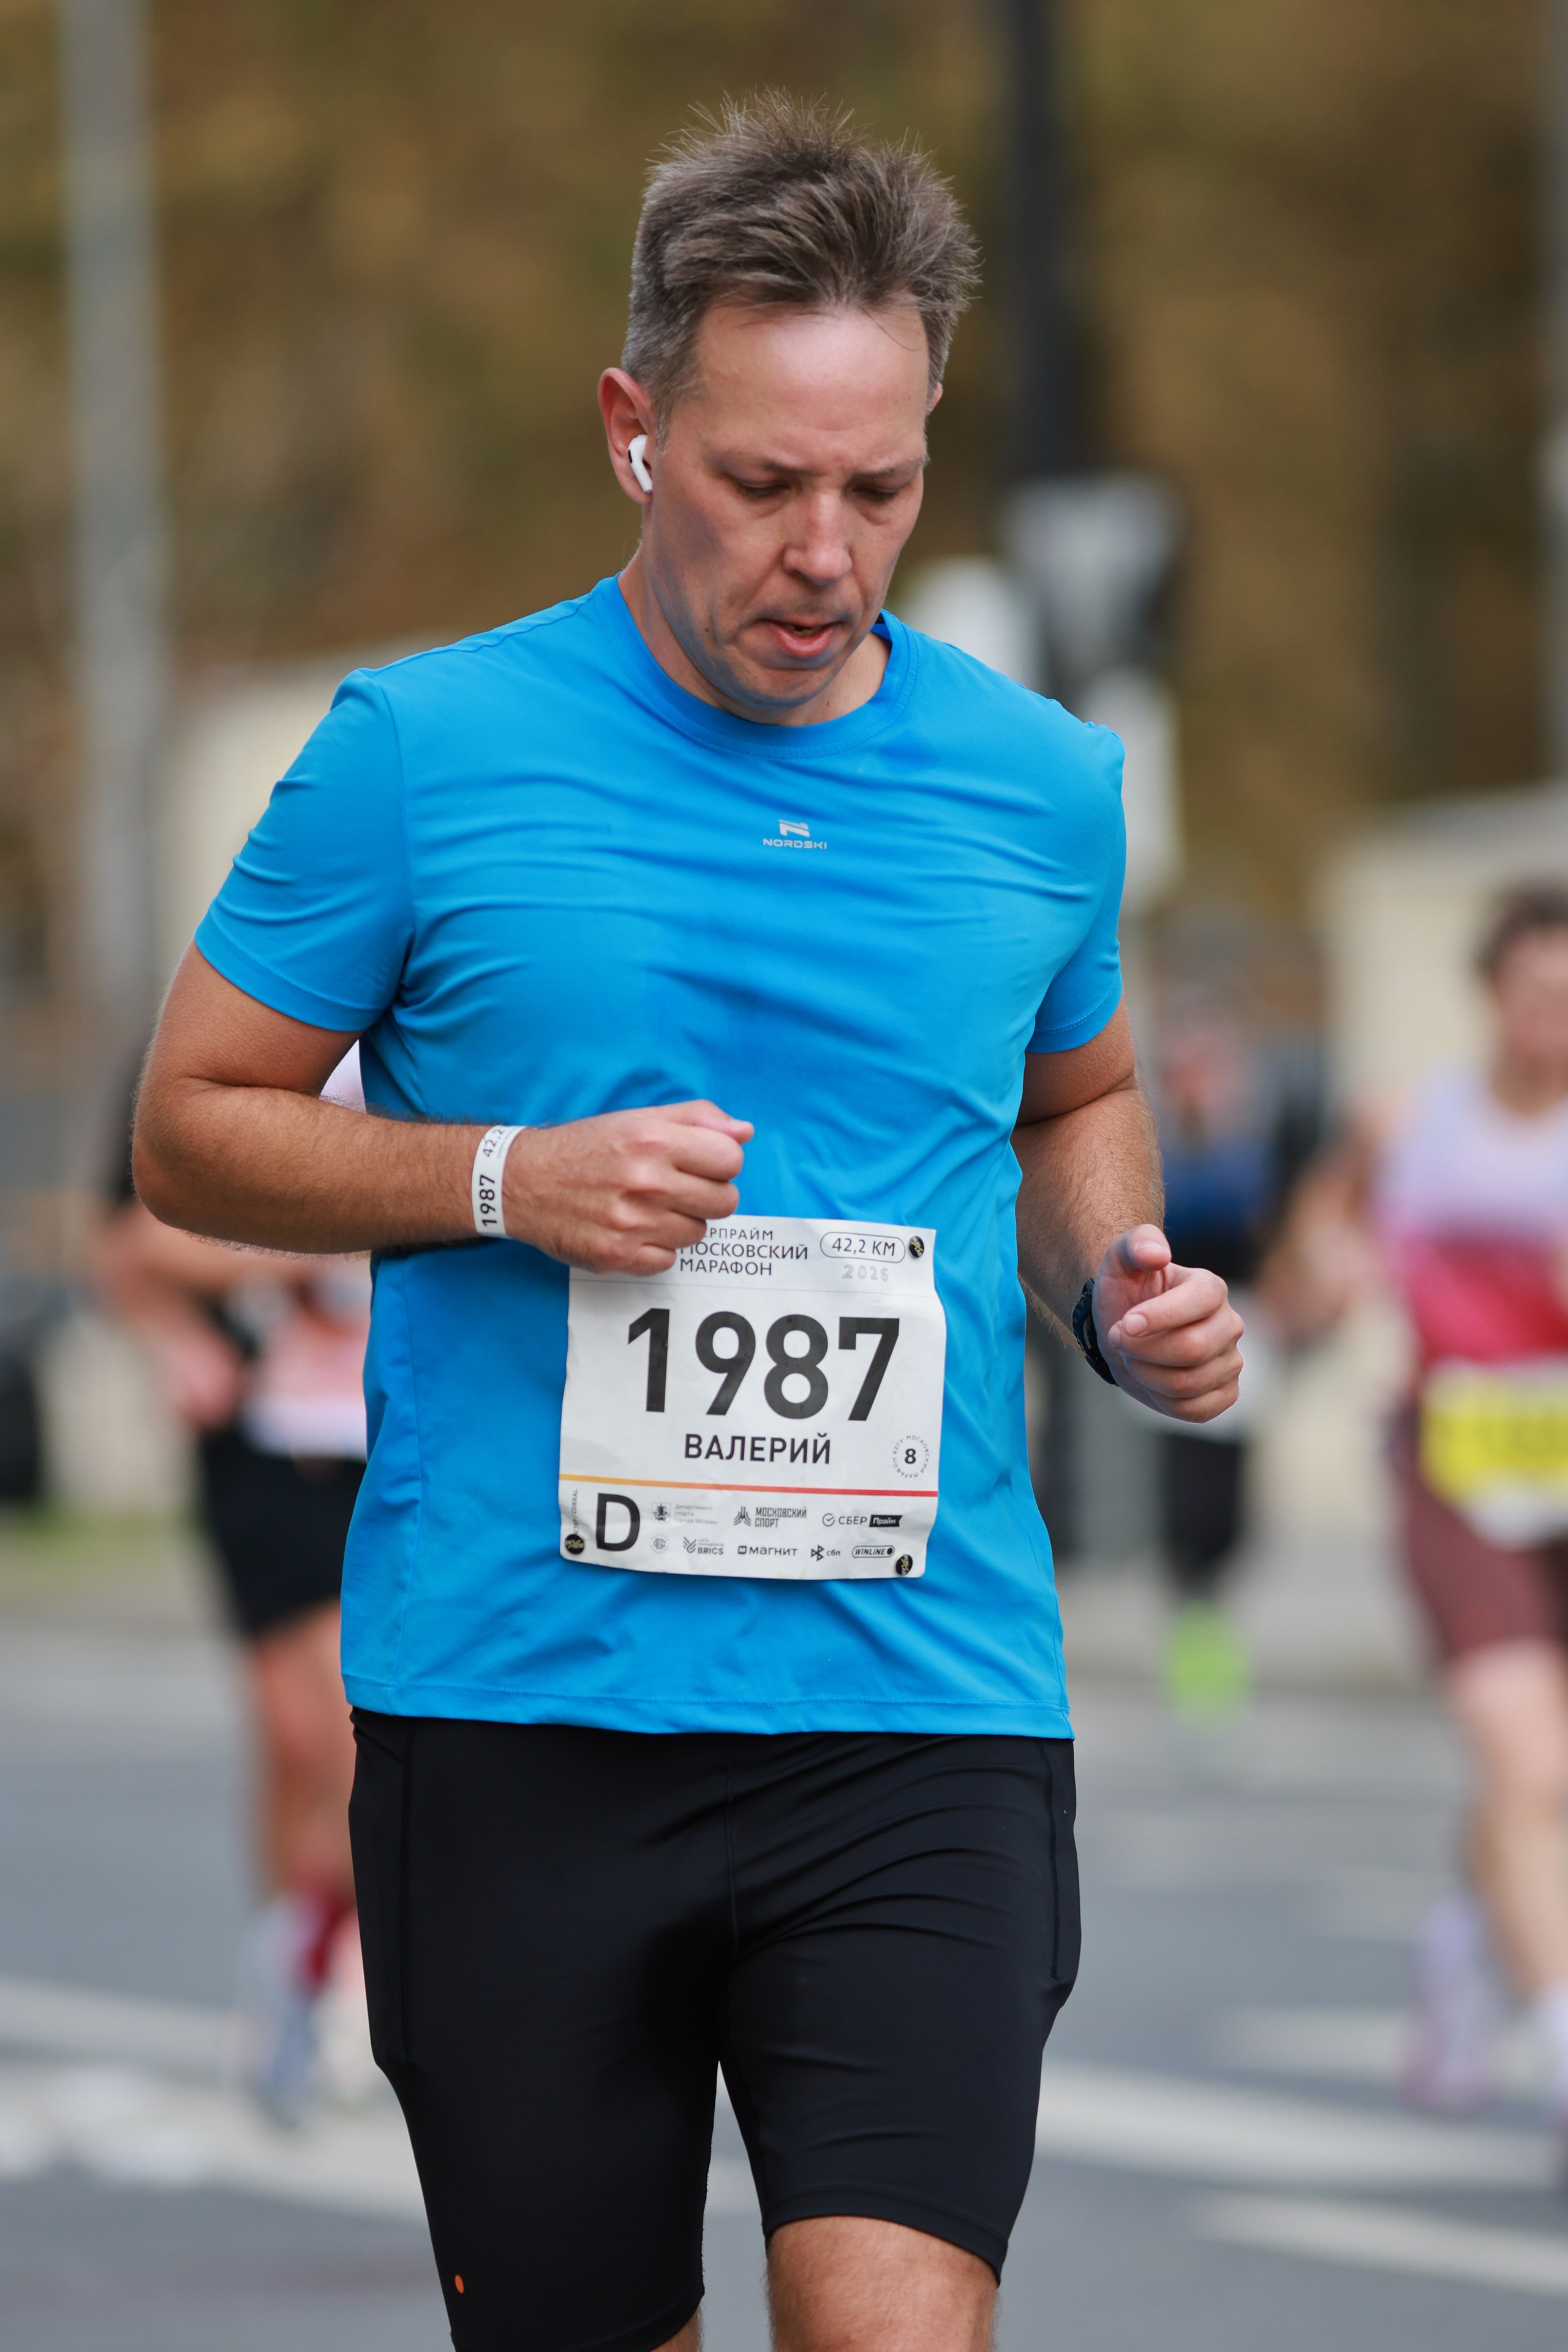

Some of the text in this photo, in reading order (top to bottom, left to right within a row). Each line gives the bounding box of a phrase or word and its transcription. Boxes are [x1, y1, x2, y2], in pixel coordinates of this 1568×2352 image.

[763, 838, 827, 850] NORDSKI
[479, 1174, 497, 1227] 1987
[704, 1227, 773, 1240] РПРАЙМ
[832, 1237, 866, 1254] 42,2
[679, 1258, 772, 1276] МАРАФОН
[842, 1264, 888, 1282] 2026
[627, 1308, 900, 1422] 1987
[684, 1433, 832, 1464] ВАЛЕРИЙ
[904, 1448, 916, 1464] 8
[755, 1506, 807, 1518] МОСКОВСКИЙ
[596, 1493, 640, 1552] D
[755, 1518, 779, 1528] СПОРТ
[839, 1515, 897, 1526] СБЕР Прайм
[854, 1547, 886, 1556] WINLINE
